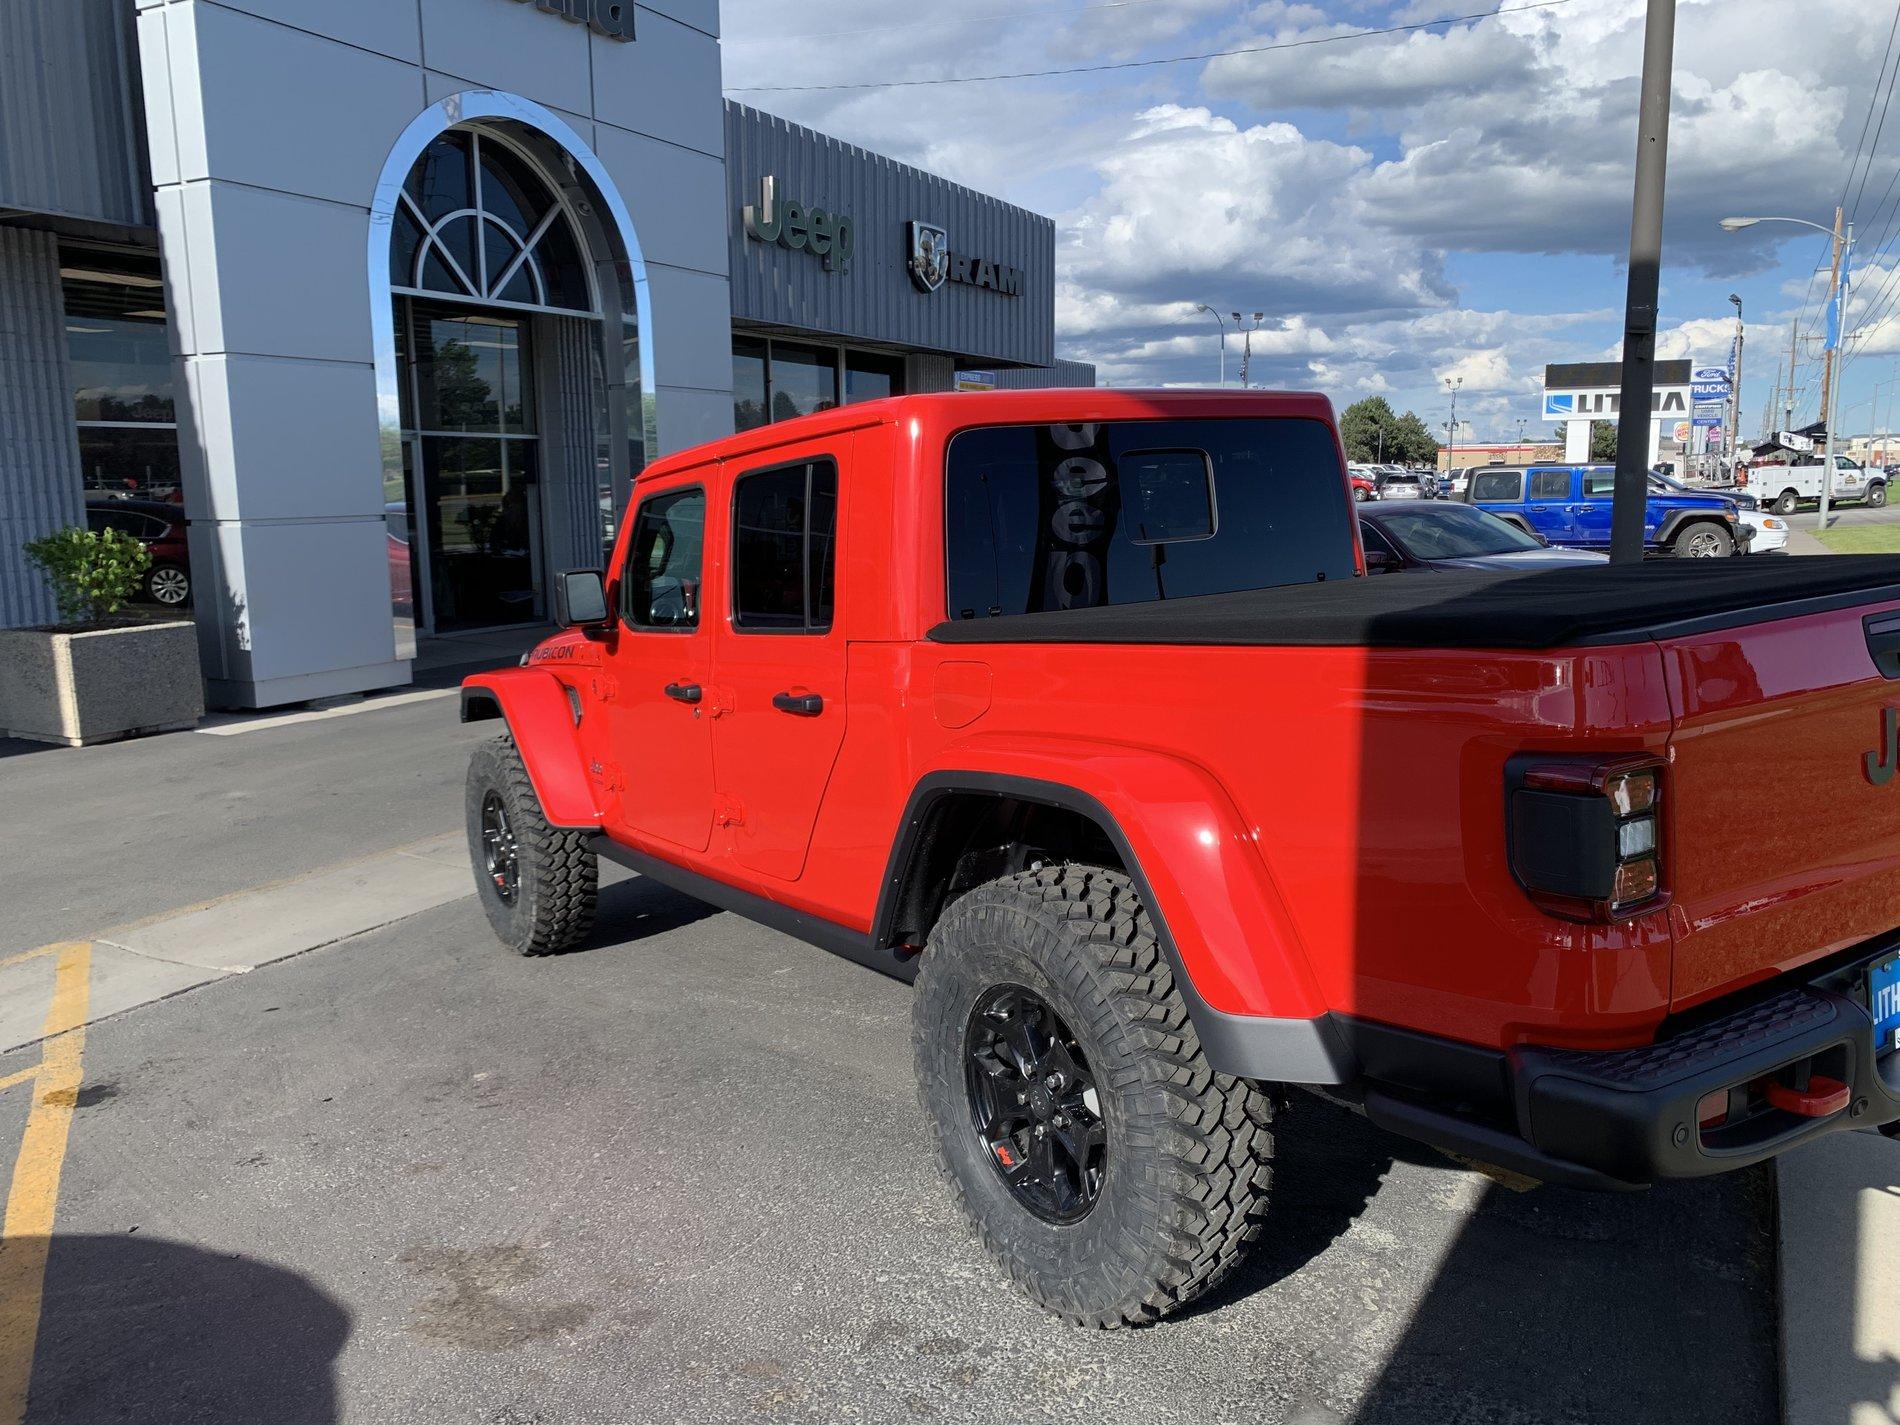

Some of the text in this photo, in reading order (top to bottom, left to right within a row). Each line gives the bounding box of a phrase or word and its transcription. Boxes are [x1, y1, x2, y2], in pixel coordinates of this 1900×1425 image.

[743, 175, 855, 271] Jeep
[949, 251, 1024, 297] RAM
[1700, 370, 1721, 378] Ford
[1690, 384, 1729, 394] TRUCKS
[1577, 391, 1686, 414] LITIA
